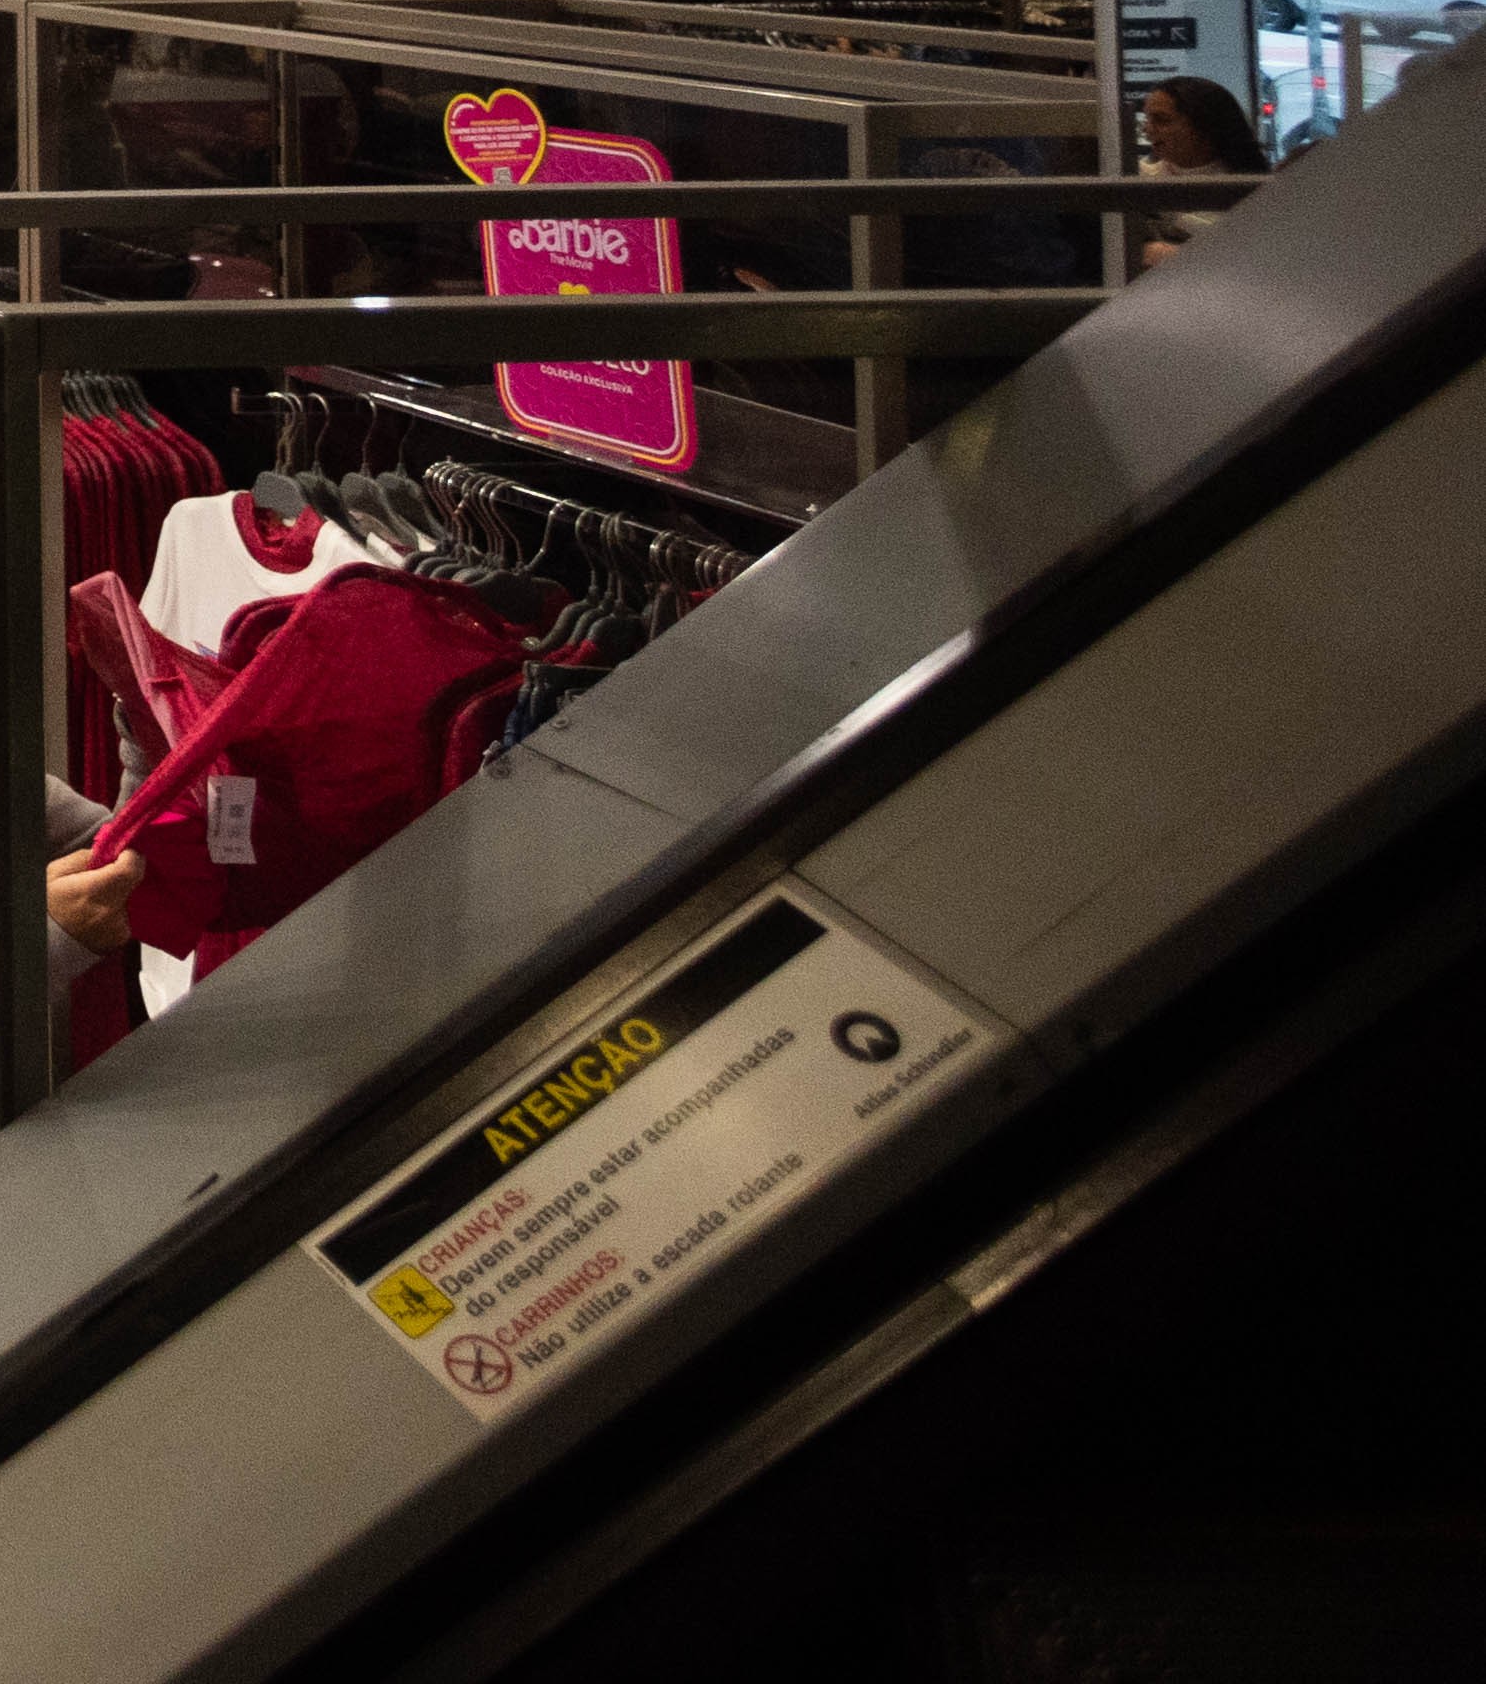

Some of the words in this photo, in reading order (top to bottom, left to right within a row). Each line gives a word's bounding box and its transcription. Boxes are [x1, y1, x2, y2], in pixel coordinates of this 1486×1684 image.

[540, 363, 583, 384] COLEÇÃO
[583, 375, 634, 395] EXCLUSIVA
[440, 1236, 516, 1297] Devem
[513, 1179, 591, 1246] sempre
[589, 1136, 644, 1187] estar
[643, 1025, 796, 1146] acompanhadas
[465, 1290, 497, 1319] do
[497, 1192, 620, 1298] responsável
[517, 1329, 566, 1371] Não
[567, 1279, 634, 1337] utilize
[634, 1266, 653, 1286] a
[651, 1208, 728, 1272] escada
[725, 1150, 804, 1213] rolante
